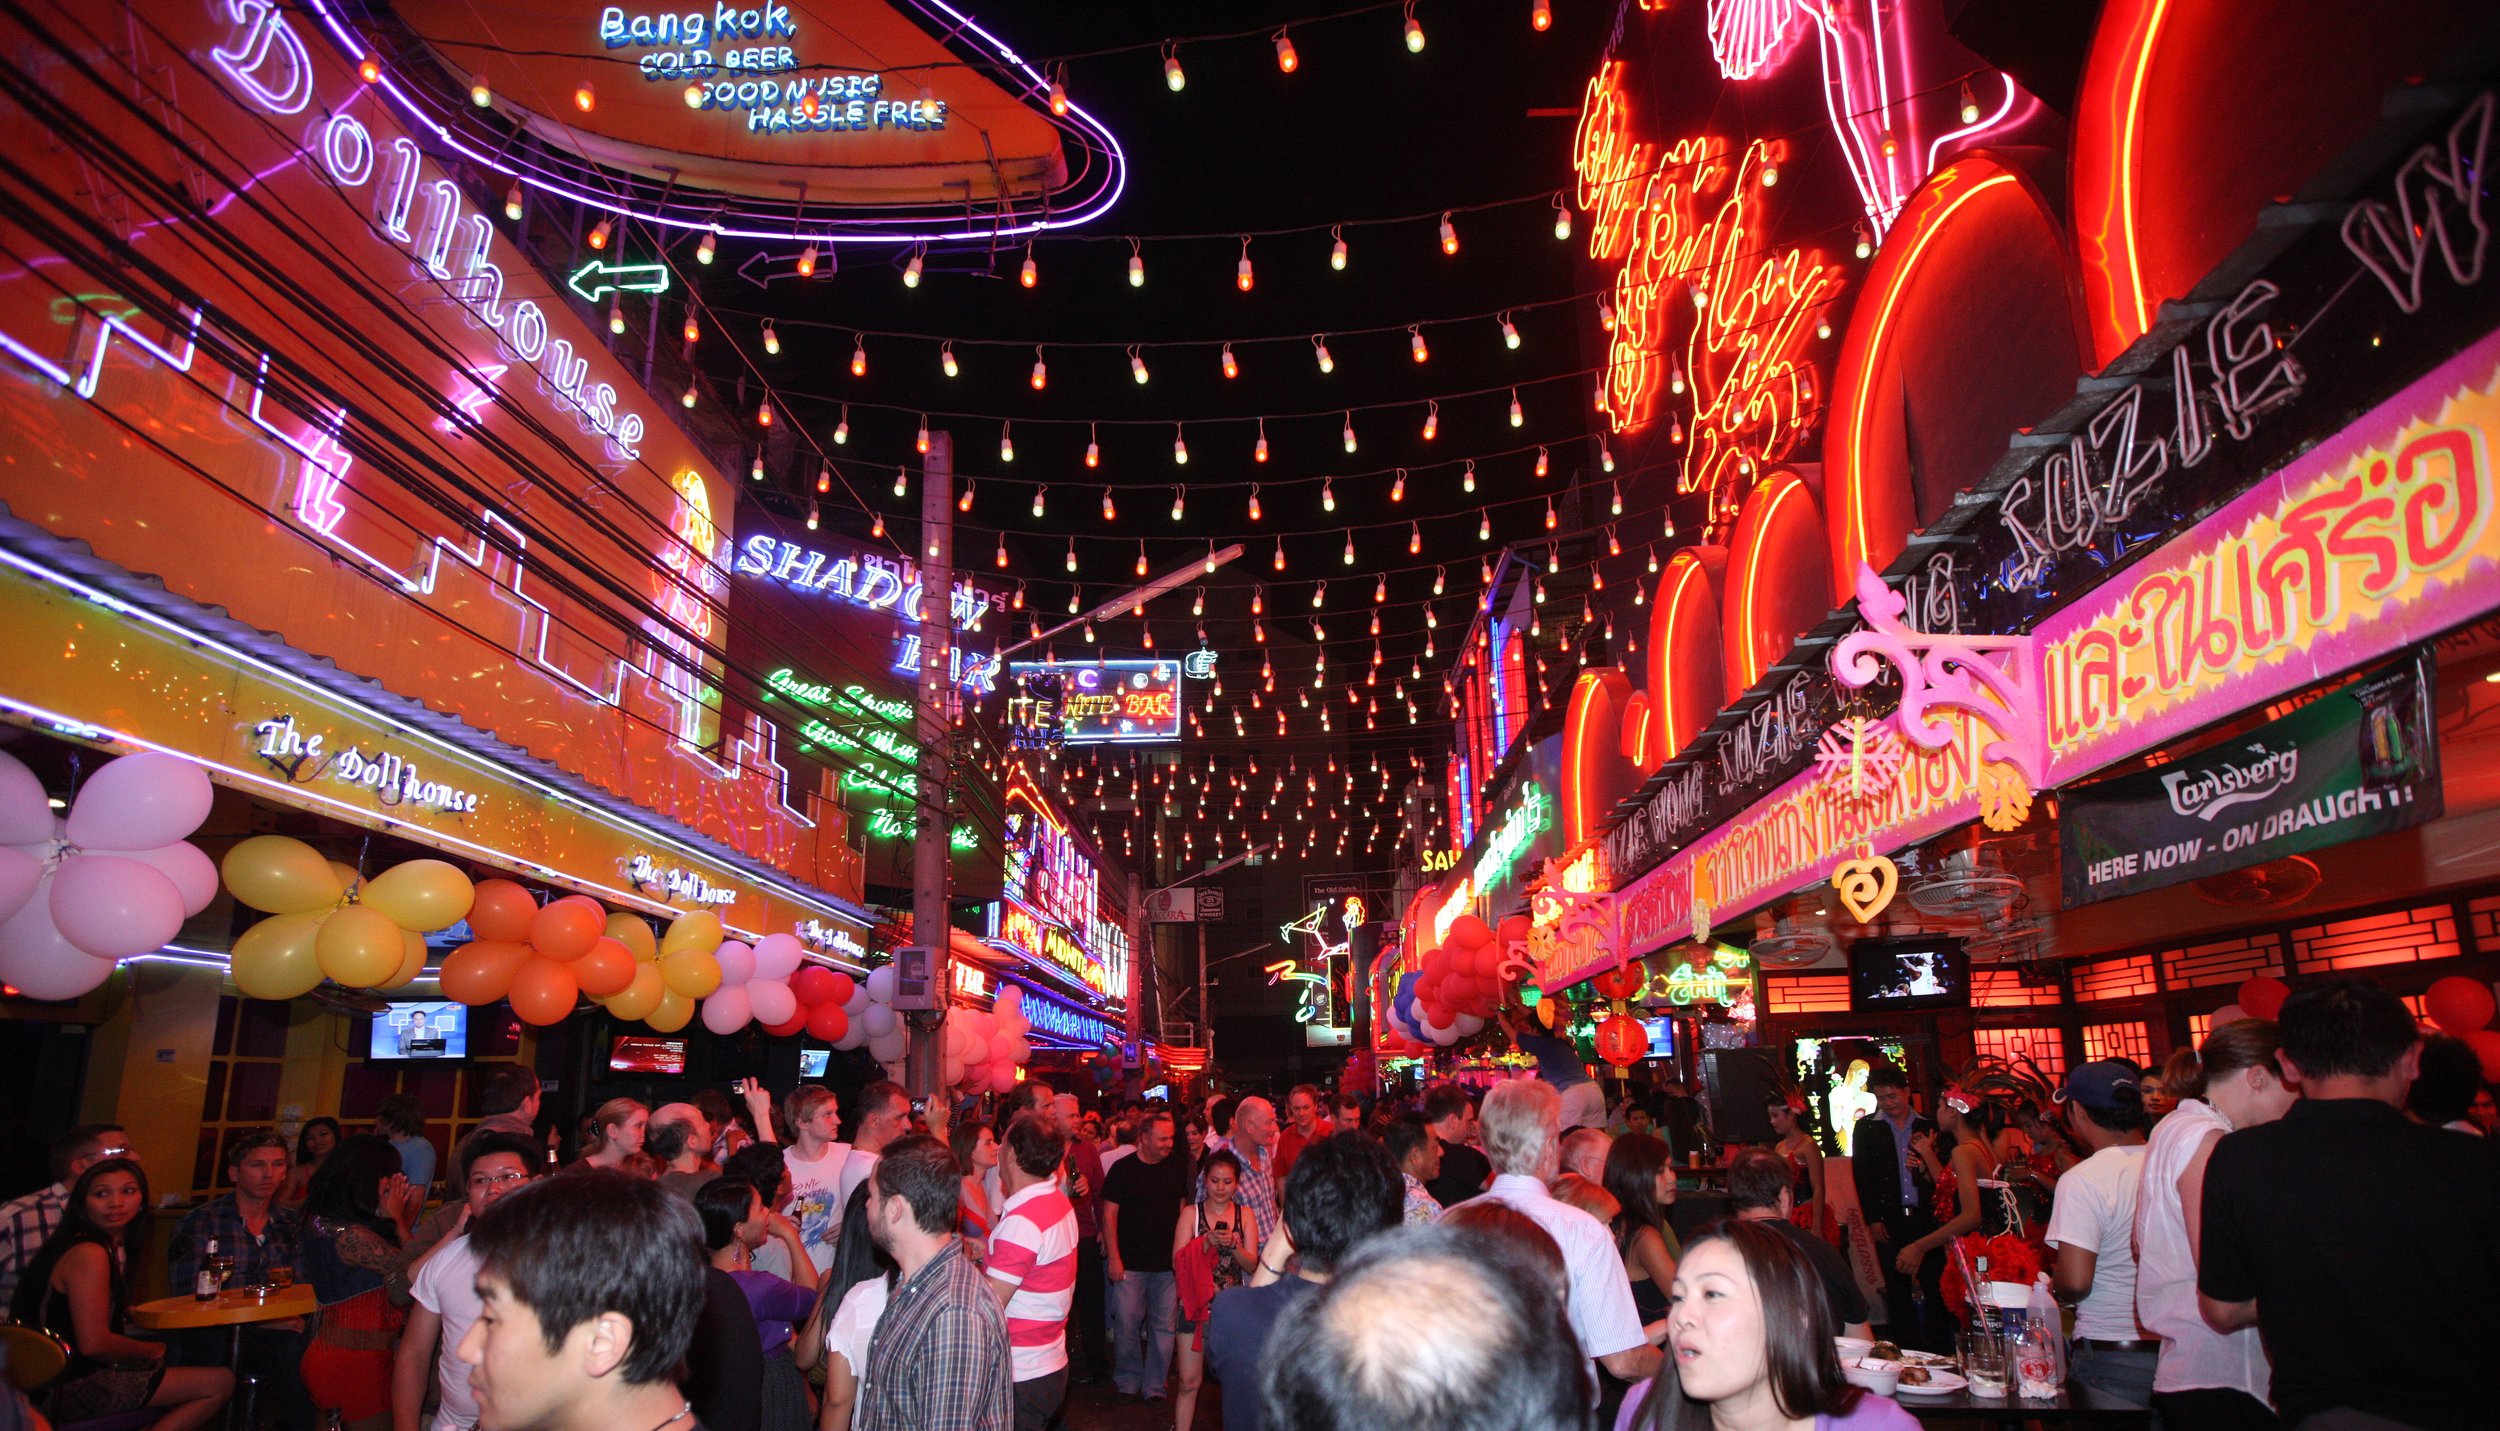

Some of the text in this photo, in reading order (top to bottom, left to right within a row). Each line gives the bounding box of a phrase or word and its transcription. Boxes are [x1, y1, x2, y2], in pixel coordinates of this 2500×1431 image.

[640, 47, 798, 73] COLD BEER
[787, 74, 882, 99] MUSIC
[748, 99, 947, 129] HASSLE FREE
[212, 0, 645, 460] Dollhouse
[2000, 280, 2305, 593] SUZIE
[896, 633, 1000, 692] BR
[1065, 693, 1175, 721] NITE BAR
[257, 715, 479, 812] The Dollhouse
[2160, 747, 2298, 818] Carlsberg
[633, 854, 658, 884] The
[2087, 853, 2138, 886] HERE
[2143, 838, 2202, 872] NOW
[2222, 821, 2259, 853] ON
[1149, 909, 1187, 921] ACCARA
[1044, 928, 1089, 982] MIDNITE
